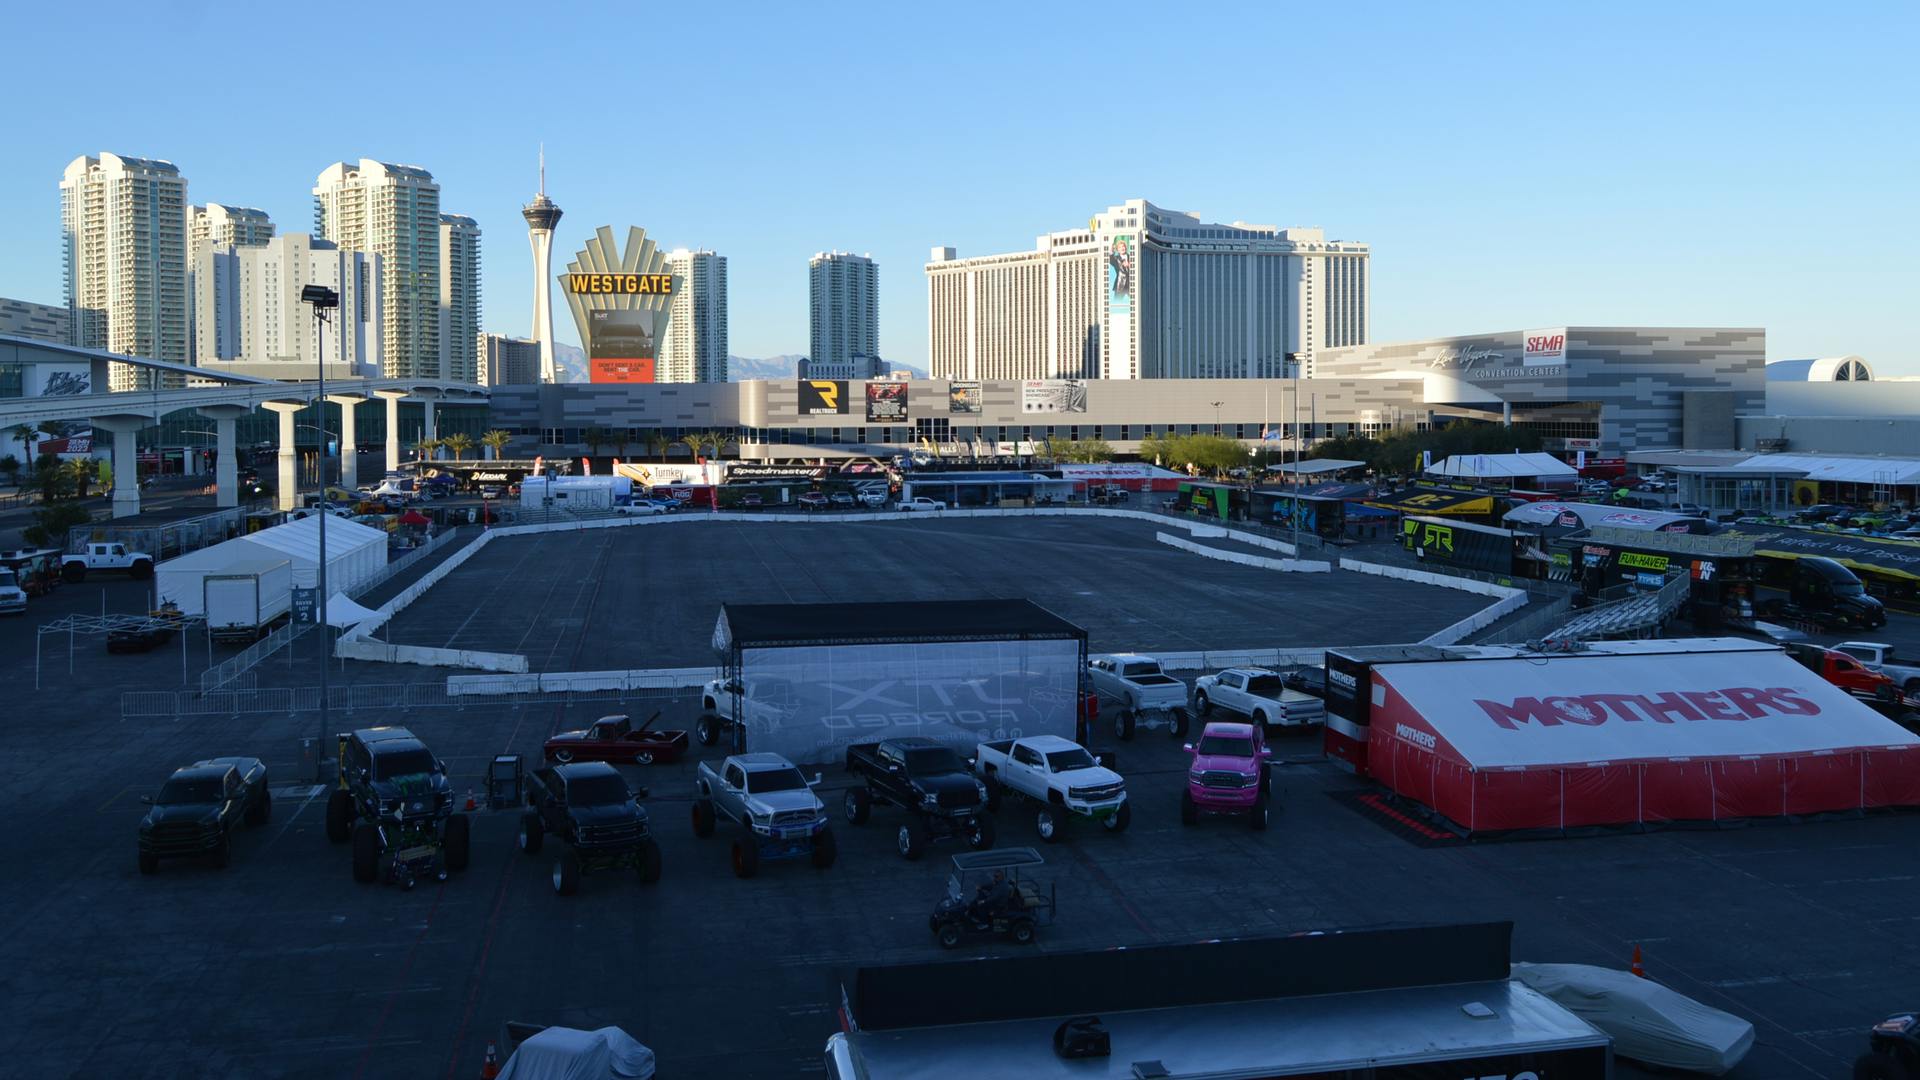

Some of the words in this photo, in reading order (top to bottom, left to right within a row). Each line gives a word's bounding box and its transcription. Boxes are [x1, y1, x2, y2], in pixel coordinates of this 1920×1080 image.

[571, 275, 671, 293] WESTGATE
[1526, 335, 1564, 353] SEMA
[1459, 344, 1504, 373] Vegas
[1475, 367, 1525, 378] CONVENTION
[1528, 367, 1561, 376] CENTER
[655, 466, 684, 479] Turnkey
[732, 467, 811, 477] Speedmaster
[1423, 524, 1454, 552] RTR
[1621, 553, 1667, 569] FUN-HAVER
[300, 612, 309, 621] 2
[1329, 668, 1357, 687] MOTHERS
[1472, 686, 1822, 731] MOTHERS
[1396, 722, 1436, 747] MOTHERS
